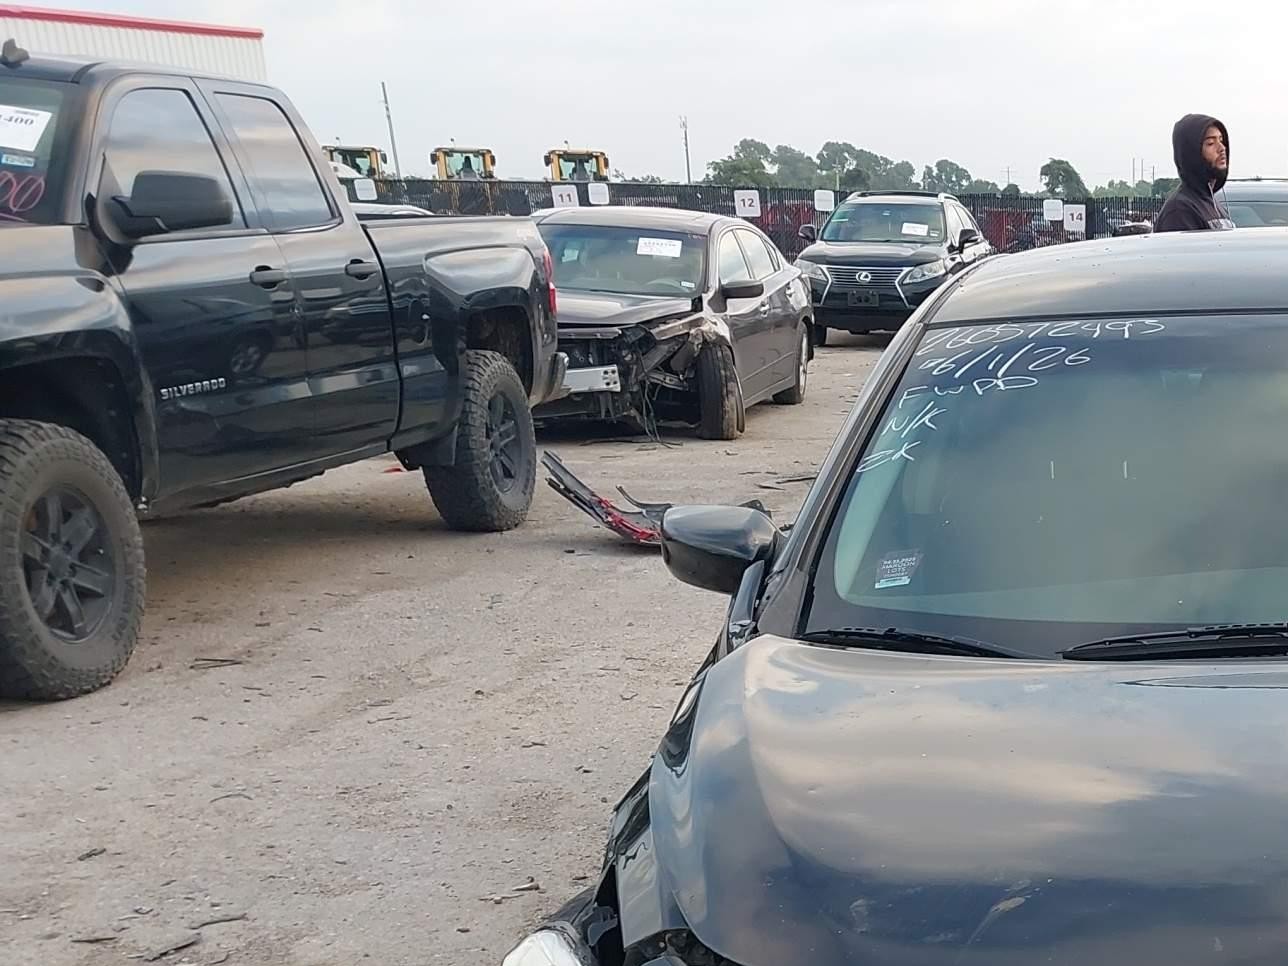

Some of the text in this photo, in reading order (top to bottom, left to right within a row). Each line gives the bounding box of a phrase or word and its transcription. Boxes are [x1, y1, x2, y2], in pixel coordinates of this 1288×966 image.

[558, 193, 572, 203] 11
[740, 198, 755, 208] 12
[1069, 212, 1083, 222] 14
[160, 377, 226, 400] SILVERADO
